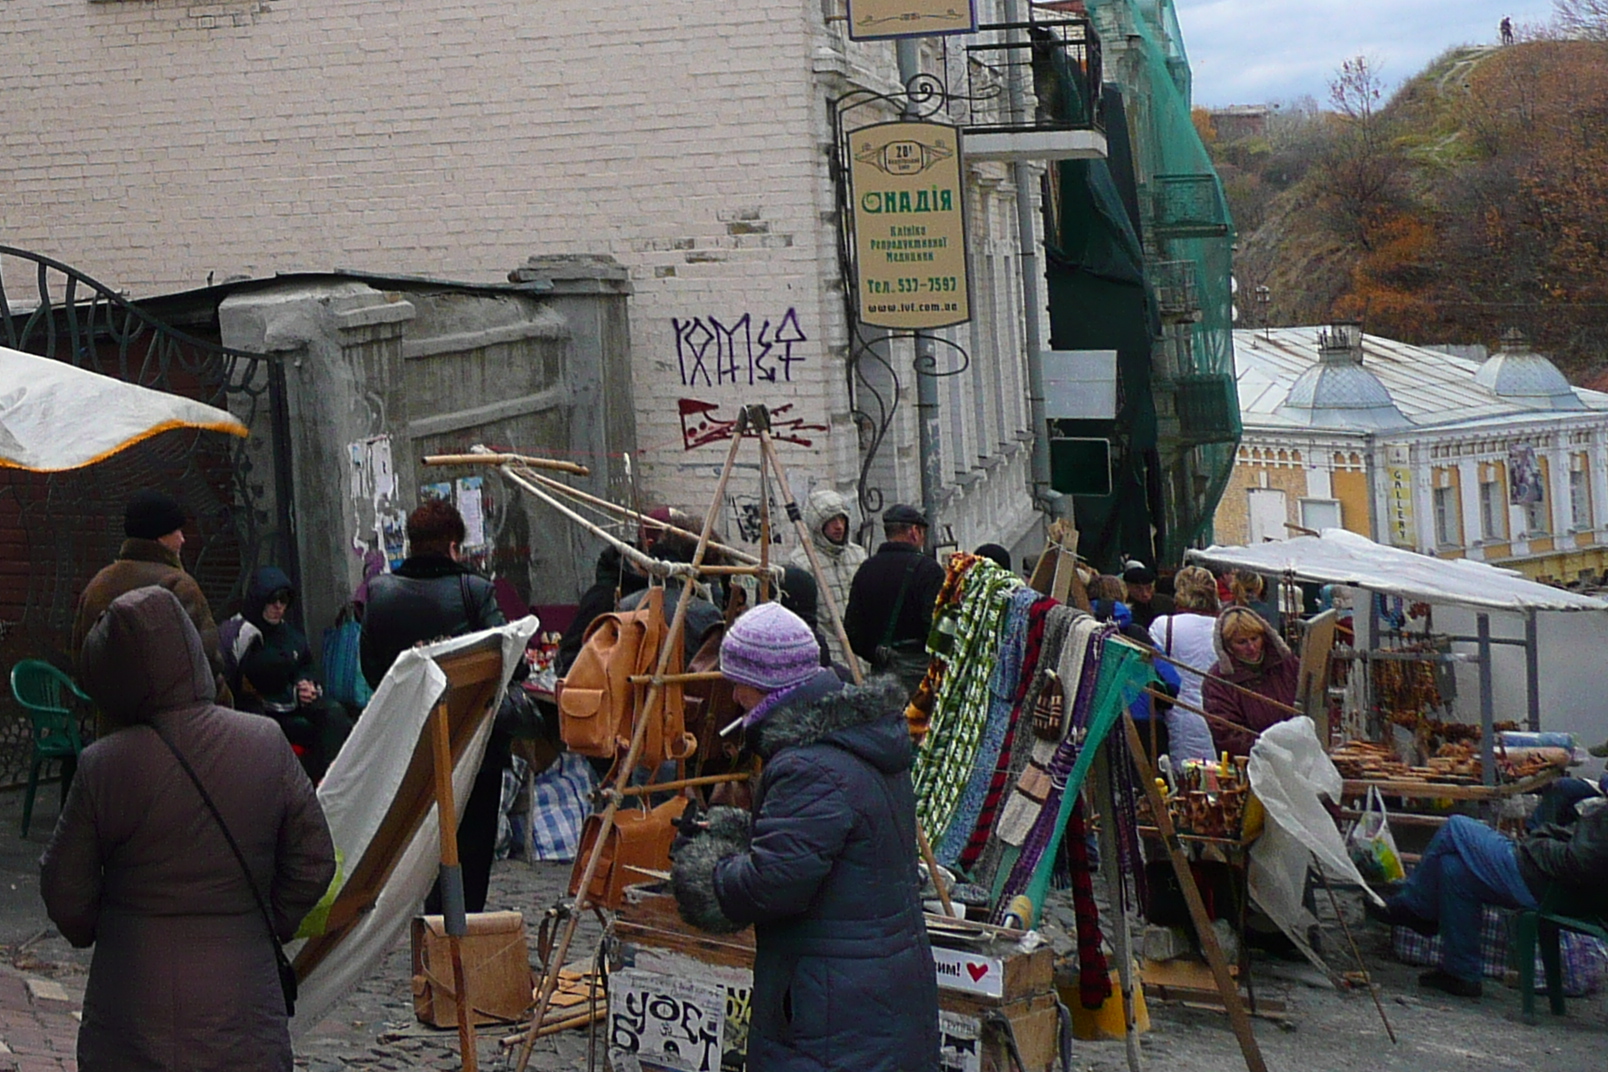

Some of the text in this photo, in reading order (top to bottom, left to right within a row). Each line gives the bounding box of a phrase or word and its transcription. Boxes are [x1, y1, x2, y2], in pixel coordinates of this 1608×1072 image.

[884, 184, 953, 213] НАДІЯ
[890, 225, 926, 237] Клініка
[867, 276, 957, 293] Тел. 537-7597
[868, 302, 958, 313] www.ivf.com.ua
[1394, 470, 1406, 539] GALLERY
